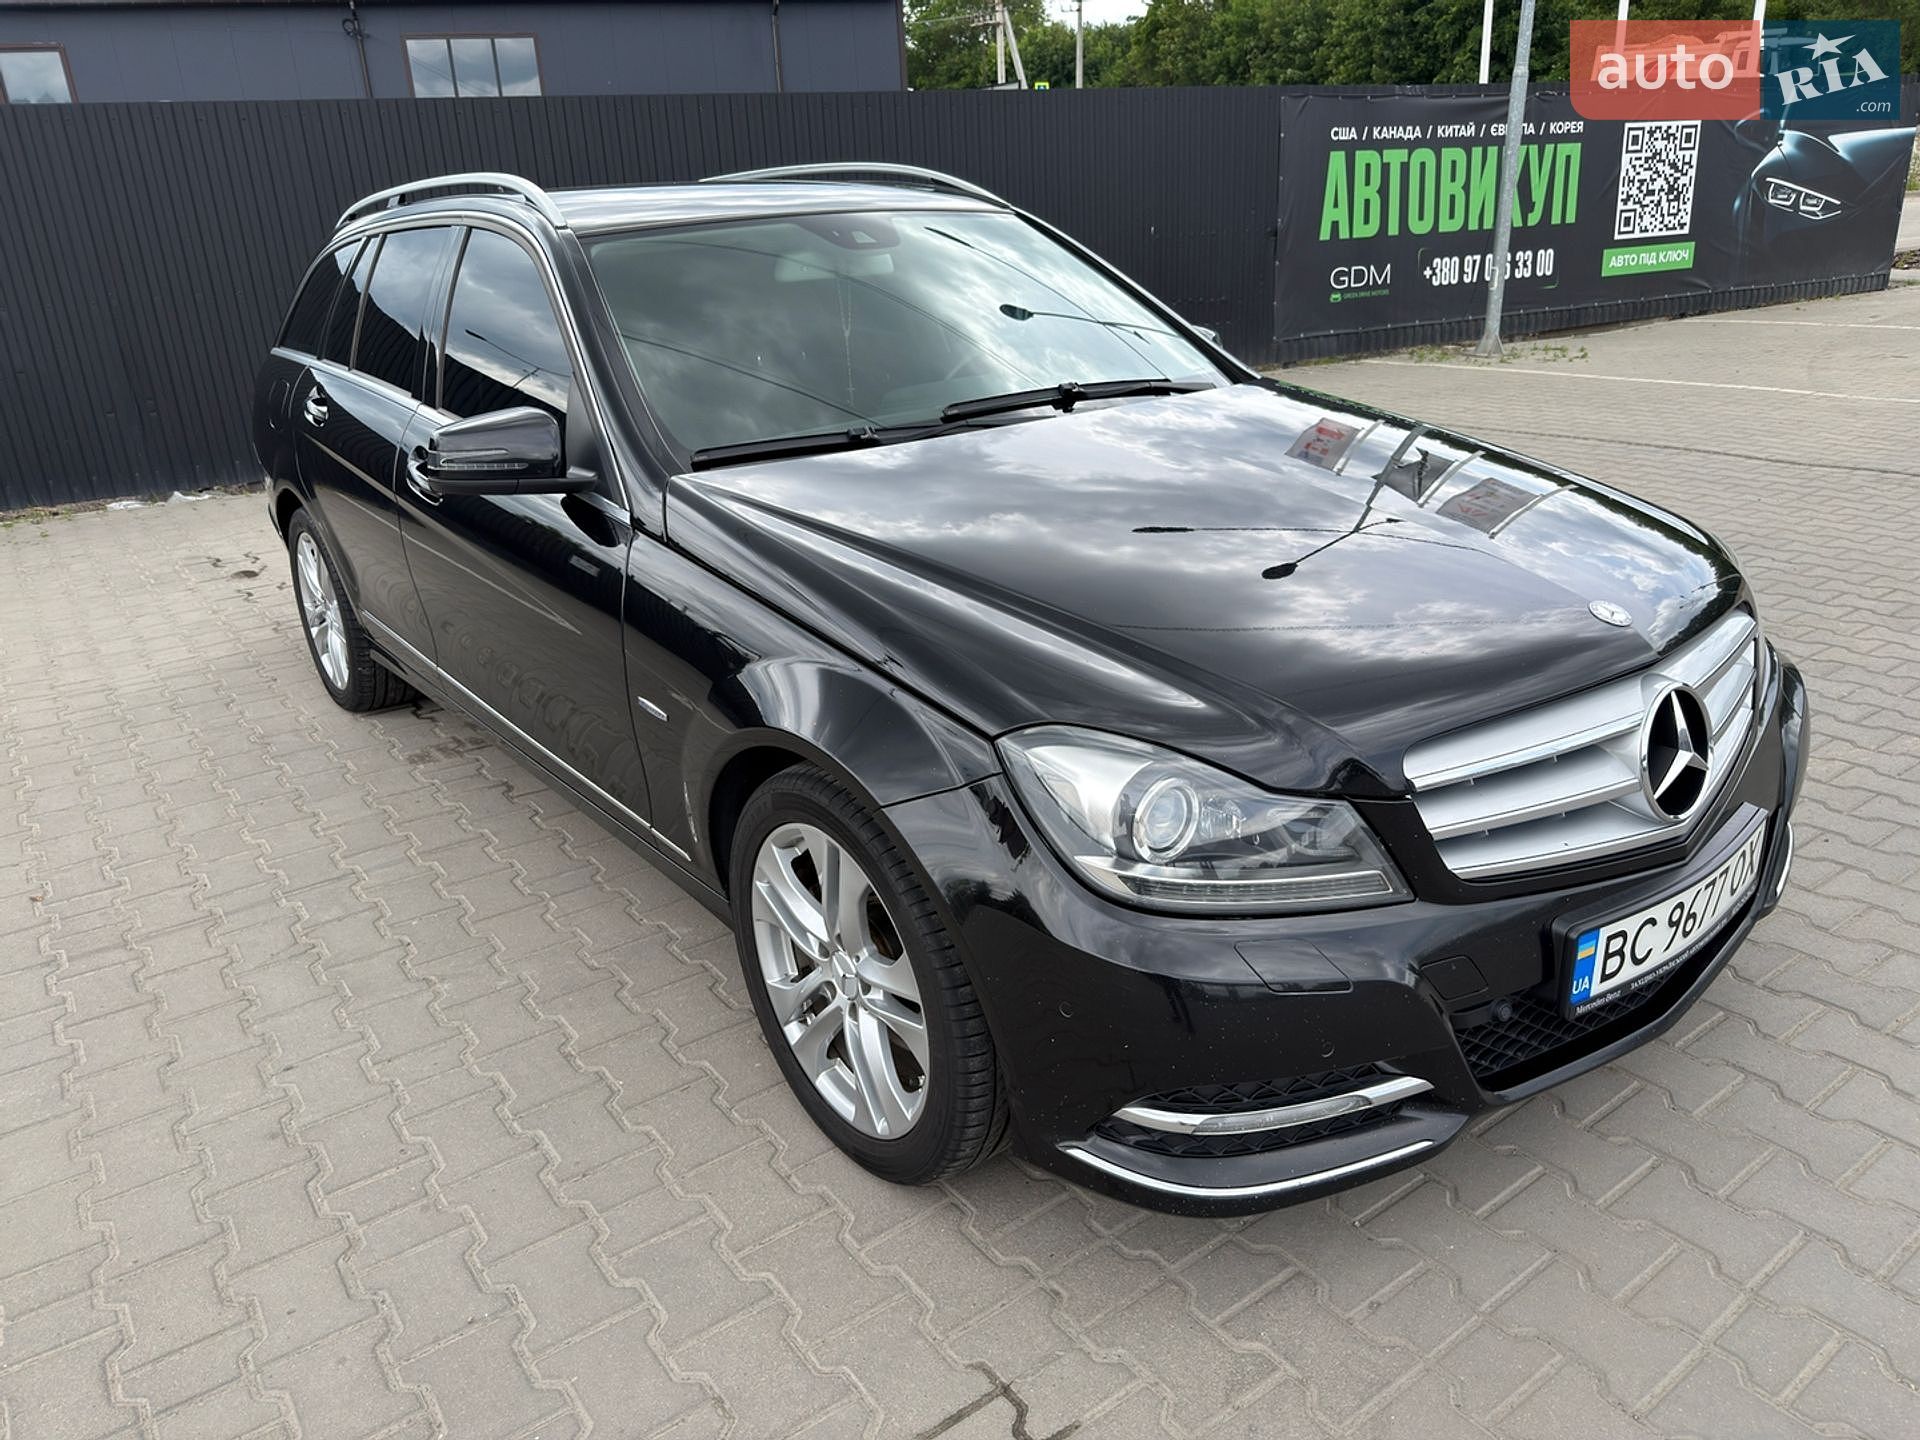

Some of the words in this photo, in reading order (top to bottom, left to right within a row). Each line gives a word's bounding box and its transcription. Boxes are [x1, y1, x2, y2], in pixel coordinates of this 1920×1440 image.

[1330, 126, 1358, 141] США
[1372, 125, 1422, 141] КАНАДА
[1437, 121, 1476, 138] КИТАЙ
[1490, 121, 1536, 137] ЄВПА
[1549, 120, 1585, 135] КОРЕЯ
[1423, 256, 1460, 287] +380
[1463, 254, 1482, 284] 97
[1484, 252, 1511, 281] 06
[1514, 250, 1533, 279] 33
[1536, 248, 1555, 277] 00
[1608, 253, 1638, 268] АВТО
[1638, 252, 1657, 266] ПІД
[1658, 248, 1689, 264] КЛЮЧ
[1329, 263, 1391, 290] GDM
[1599, 917, 1658, 985] BC
[1662, 865, 1731, 953] 9677
[1730, 829, 1762, 896] OX
[1572, 975, 1590, 995] UA
